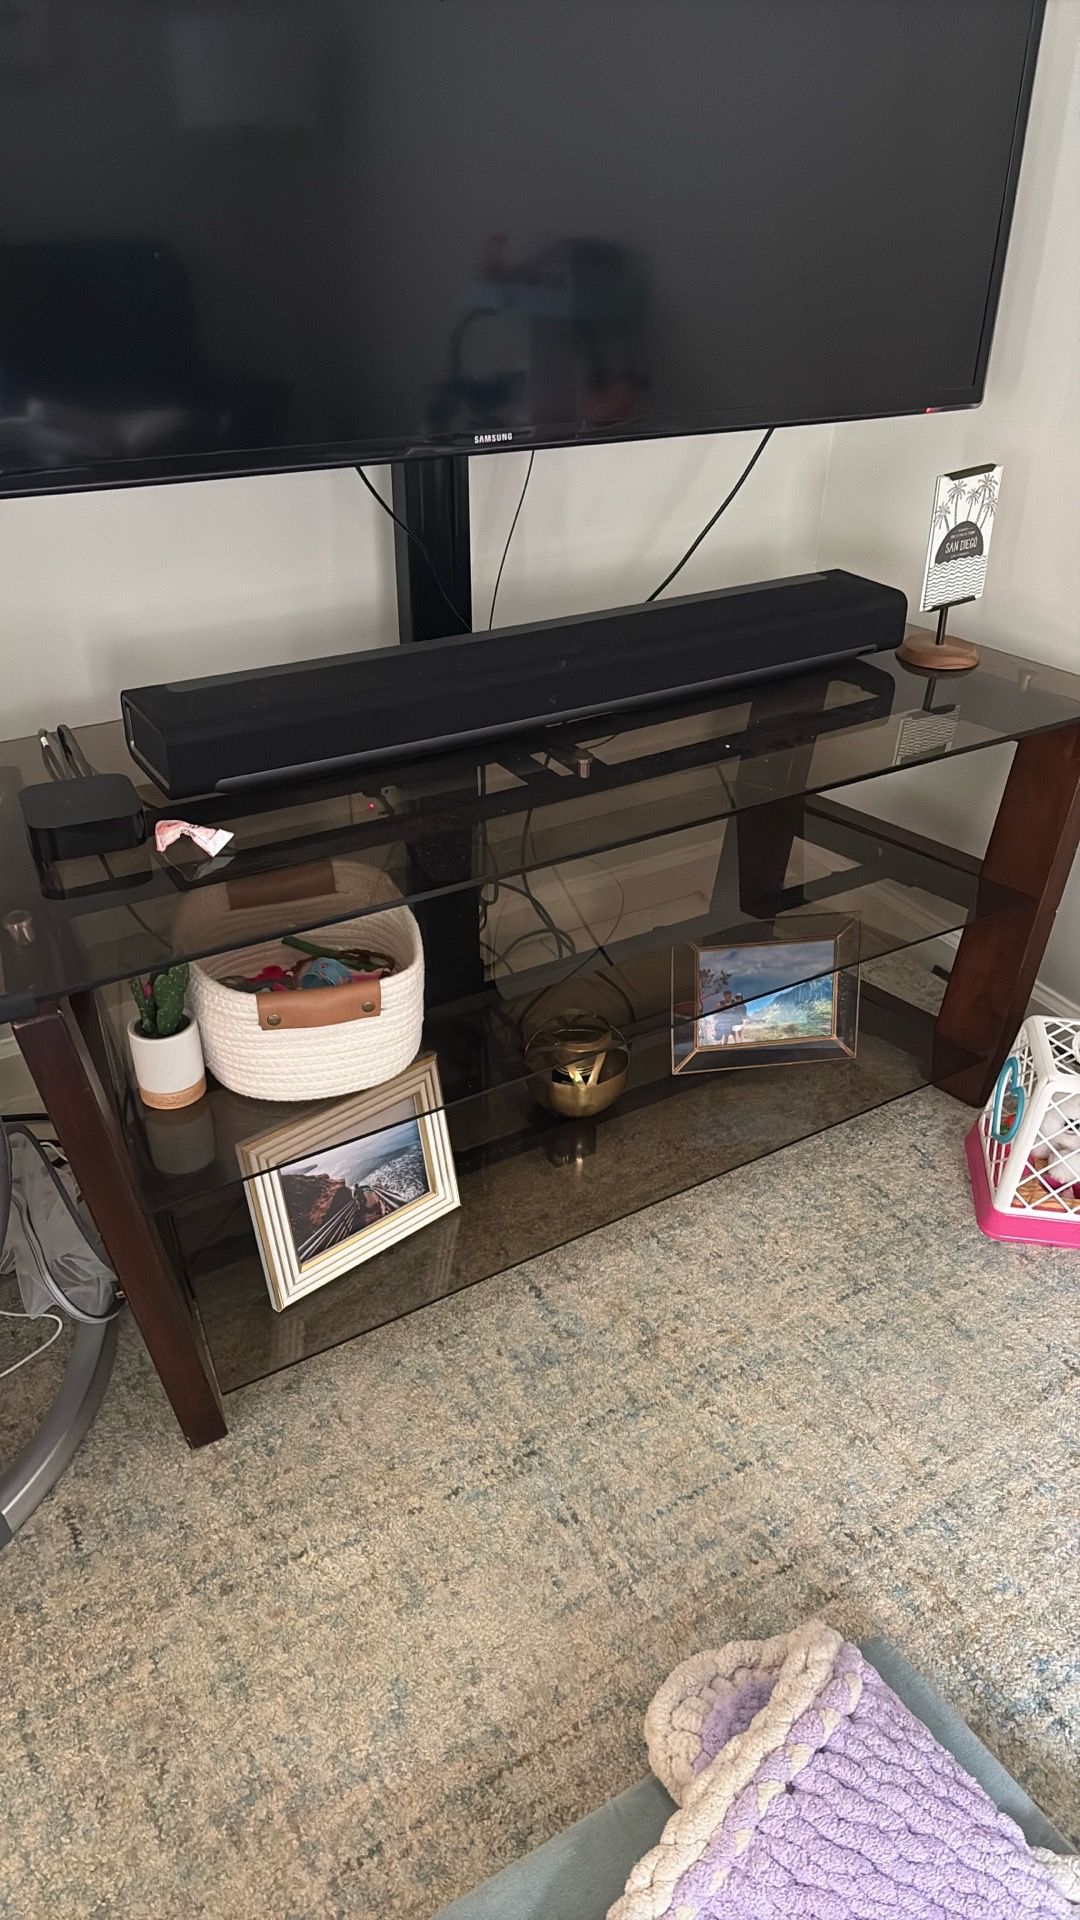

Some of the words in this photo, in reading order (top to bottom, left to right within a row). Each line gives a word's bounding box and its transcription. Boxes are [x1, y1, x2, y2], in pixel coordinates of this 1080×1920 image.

[474, 432, 513, 444] SAMSUNG
[945, 540, 959, 554] SAN
[960, 536, 978, 551] DIEGO
